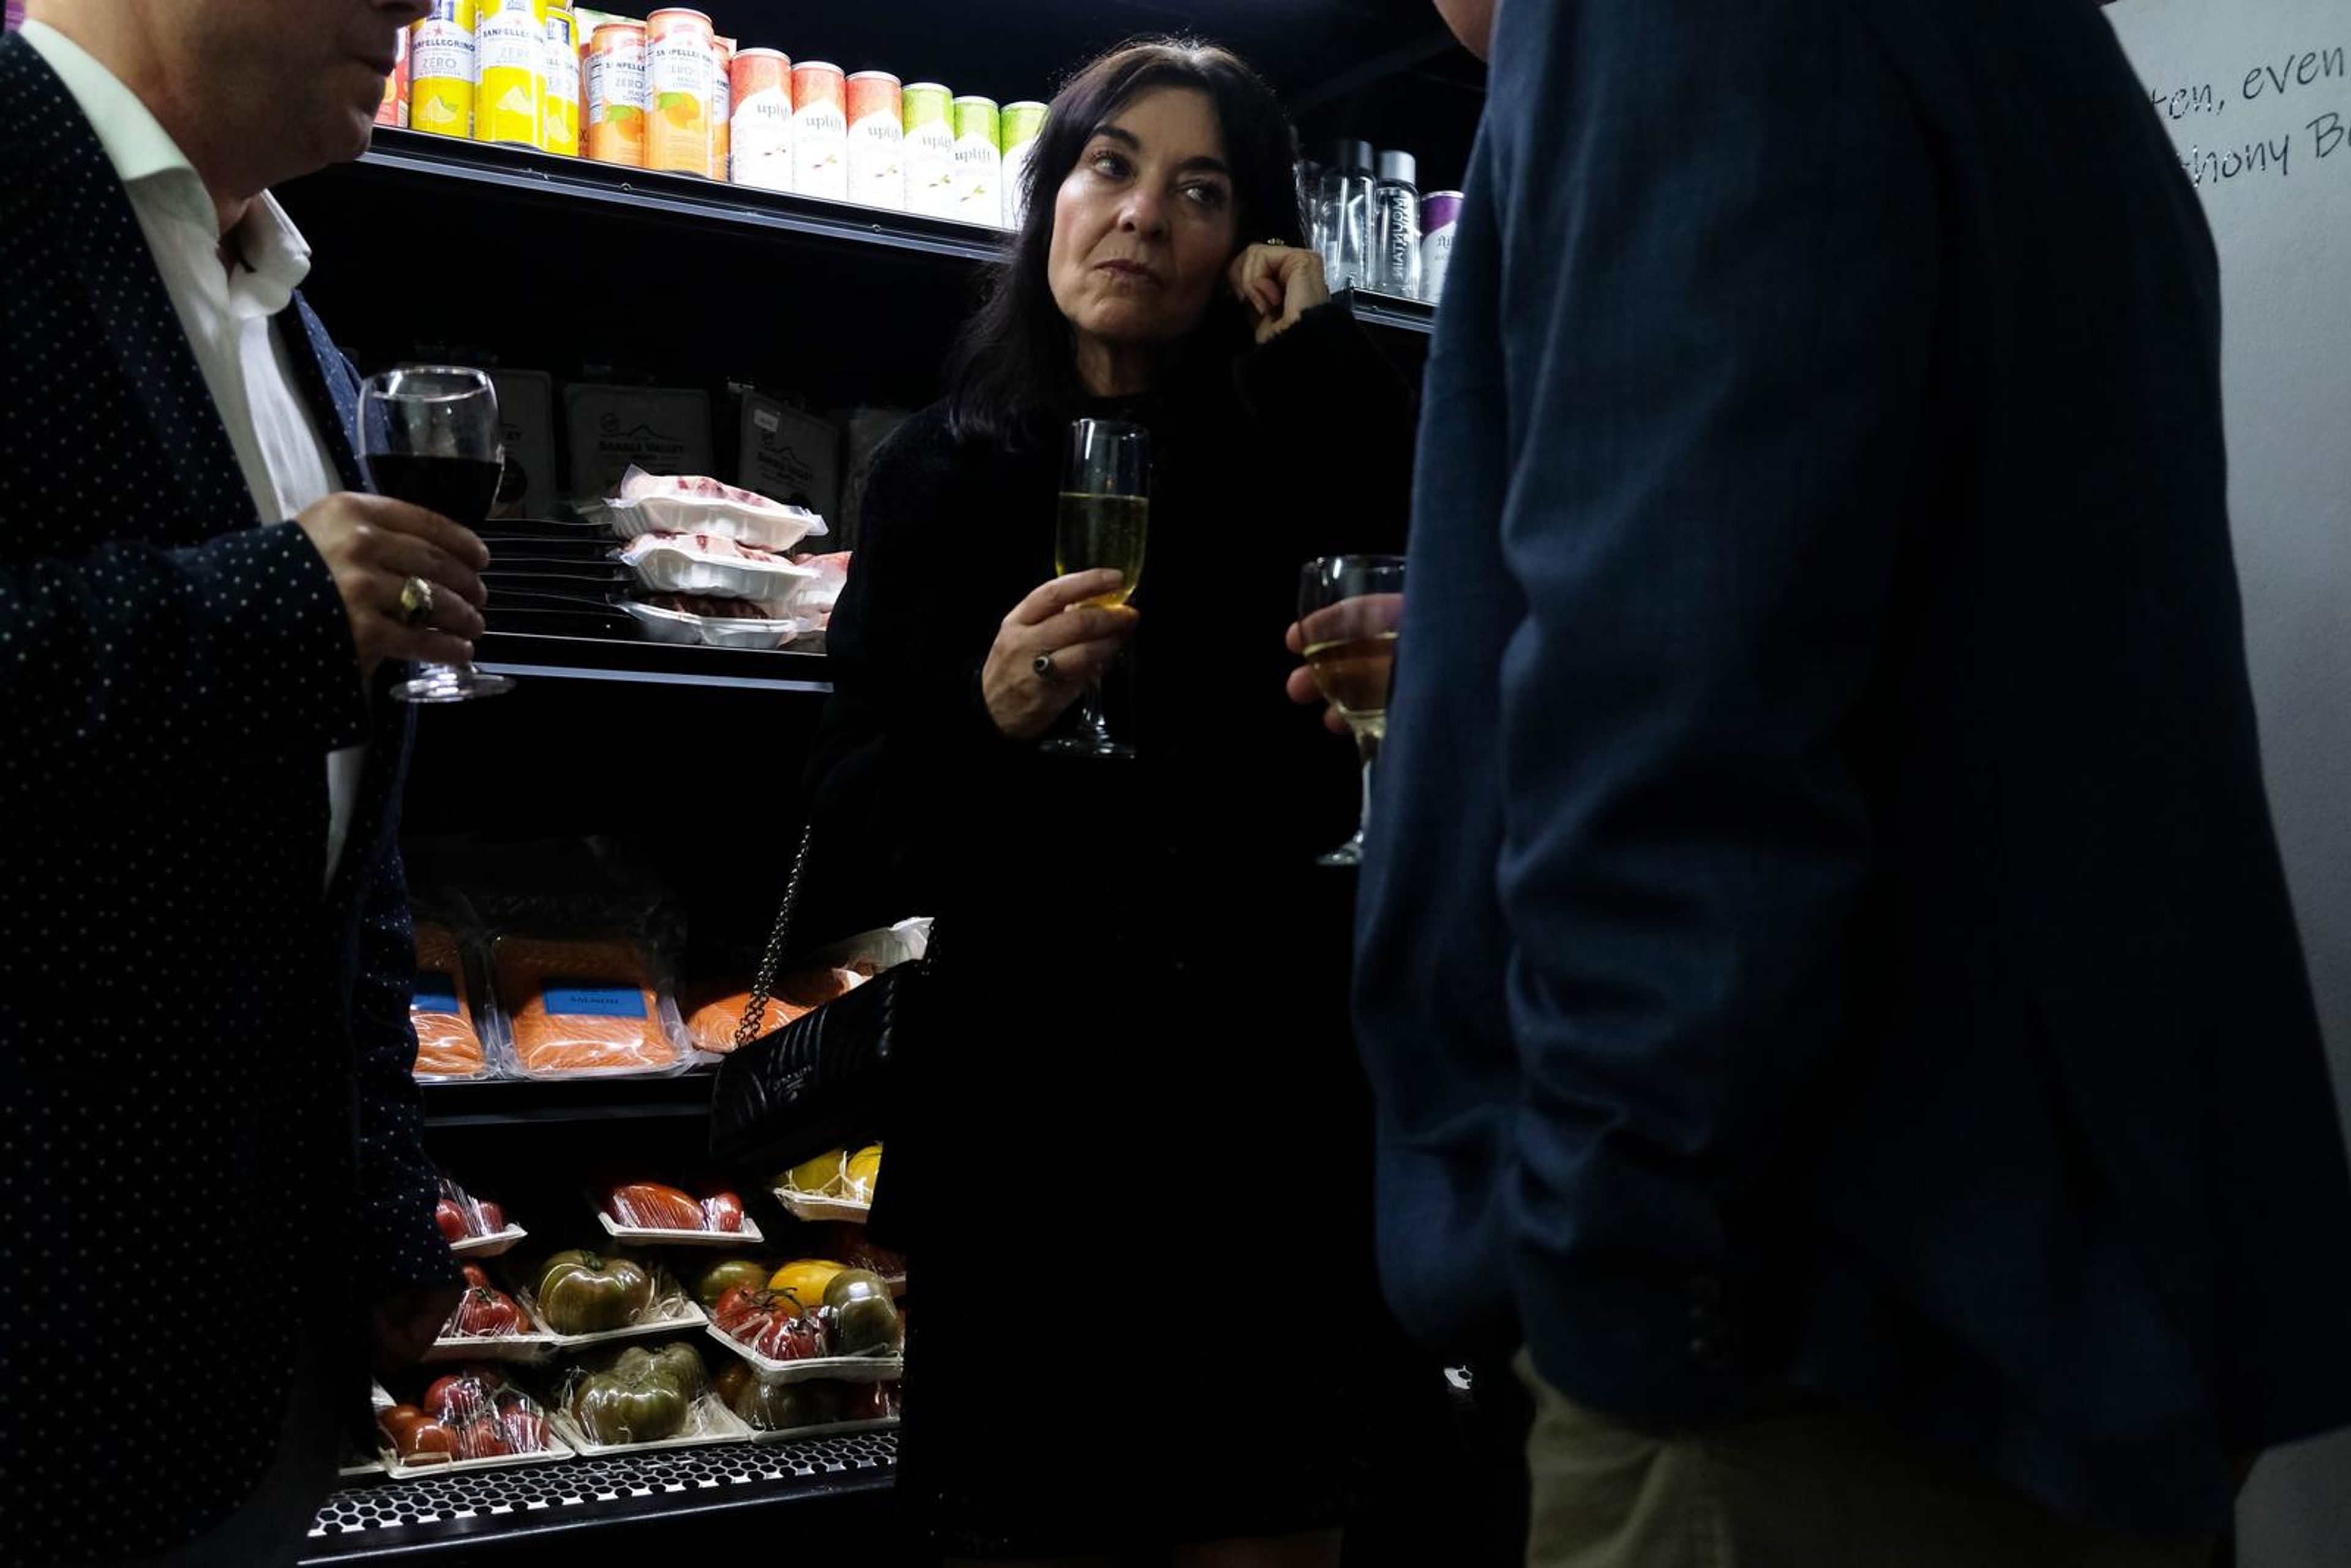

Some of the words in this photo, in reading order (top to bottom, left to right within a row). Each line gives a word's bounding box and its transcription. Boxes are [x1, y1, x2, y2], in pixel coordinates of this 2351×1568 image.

[422, 58, 457, 69] ZERO
[2151, 84, 2225, 119] ten,
[2243, 47, 2344, 100] even
[2181, 133, 2290, 186] hony
[2306, 111, 2351, 159] B
